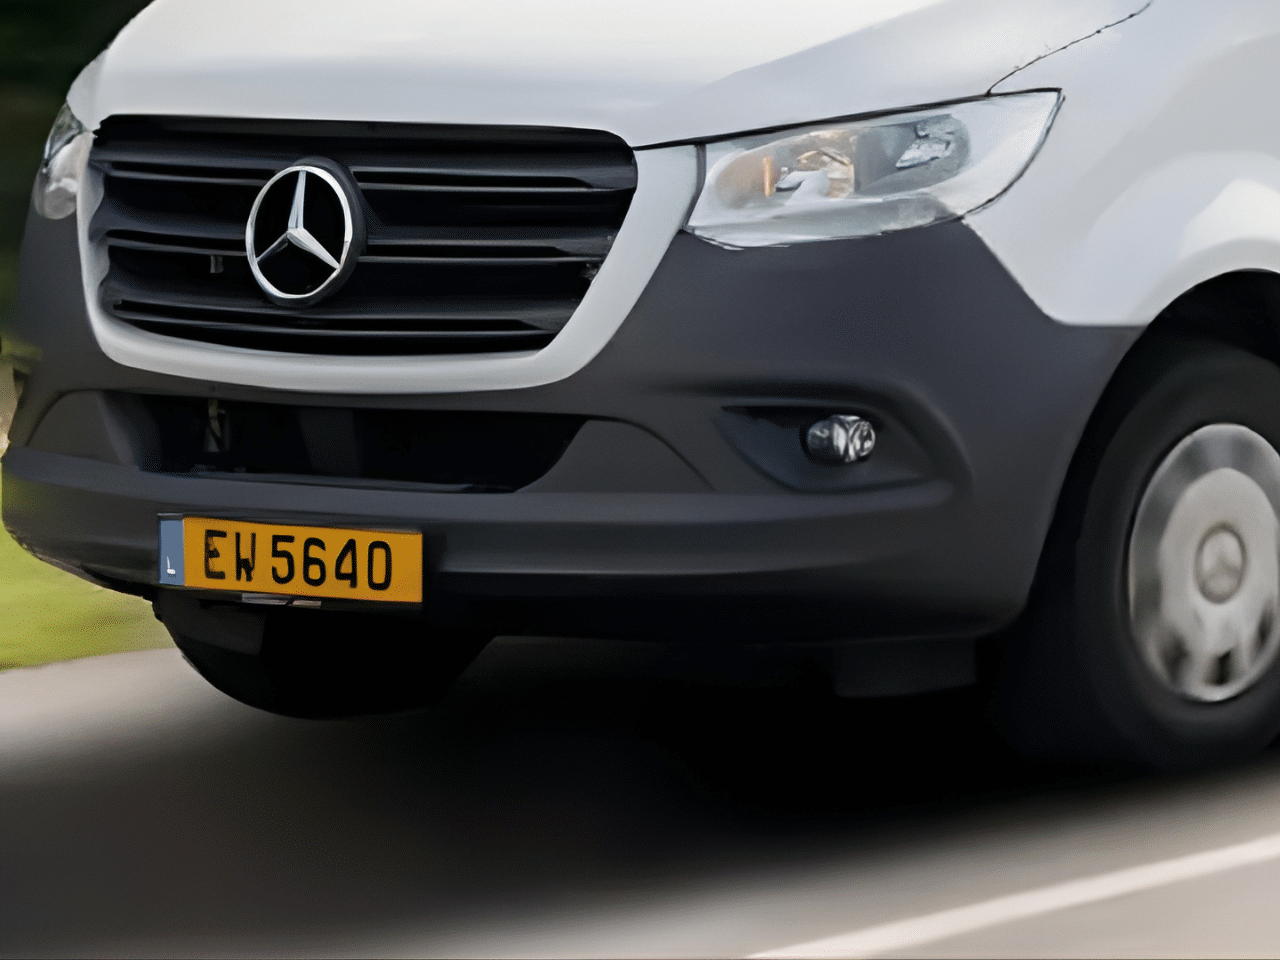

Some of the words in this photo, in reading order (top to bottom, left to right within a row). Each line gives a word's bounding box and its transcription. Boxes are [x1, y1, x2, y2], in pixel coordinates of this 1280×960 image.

[165, 555, 177, 575] L
[204, 529, 257, 582] EW
[271, 535, 393, 591] 5640
